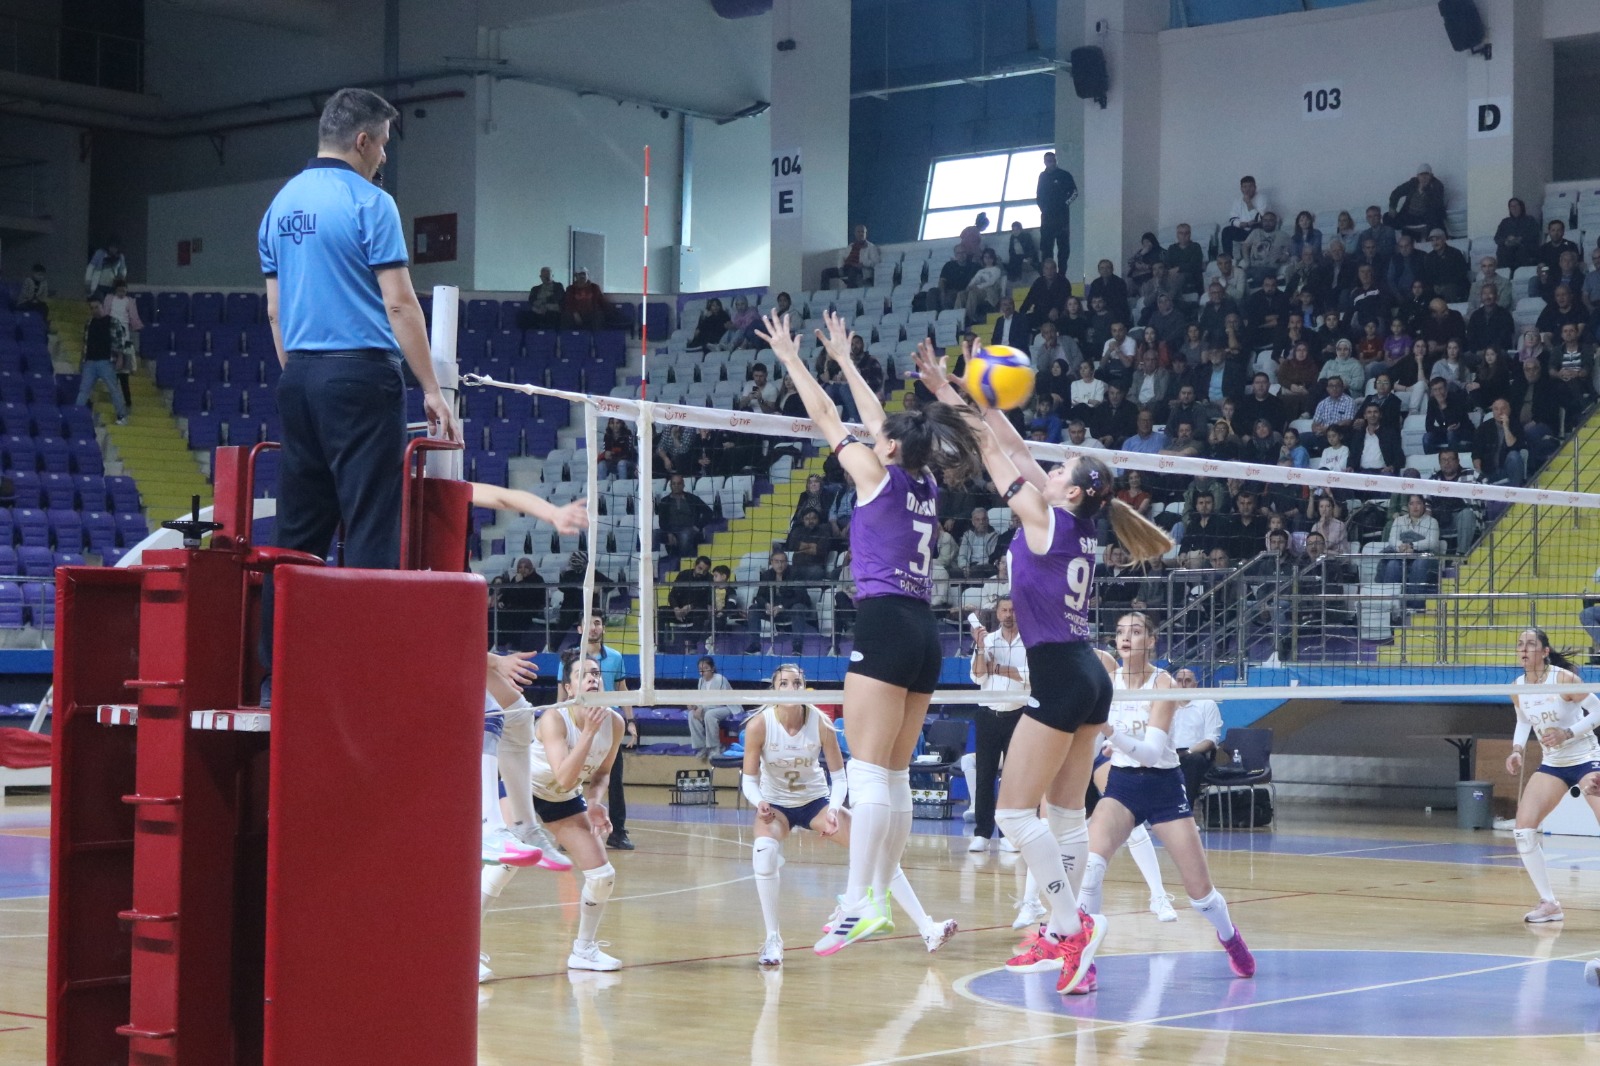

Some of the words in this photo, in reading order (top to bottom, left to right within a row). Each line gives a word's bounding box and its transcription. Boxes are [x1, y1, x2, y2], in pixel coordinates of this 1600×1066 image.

[1303, 88, 1342, 113] 103
[1478, 104, 1501, 132] D
[771, 155, 802, 177] 104
[779, 190, 794, 214] E
[674, 412, 687, 420] TVF
[801, 424, 813, 432] TVF
[1119, 456, 1129, 464] TVF
[909, 519, 933, 577] 3
[1064, 556, 1090, 612] 9
[1541, 710, 1560, 724] Ptt
[784, 770, 807, 793] 2
